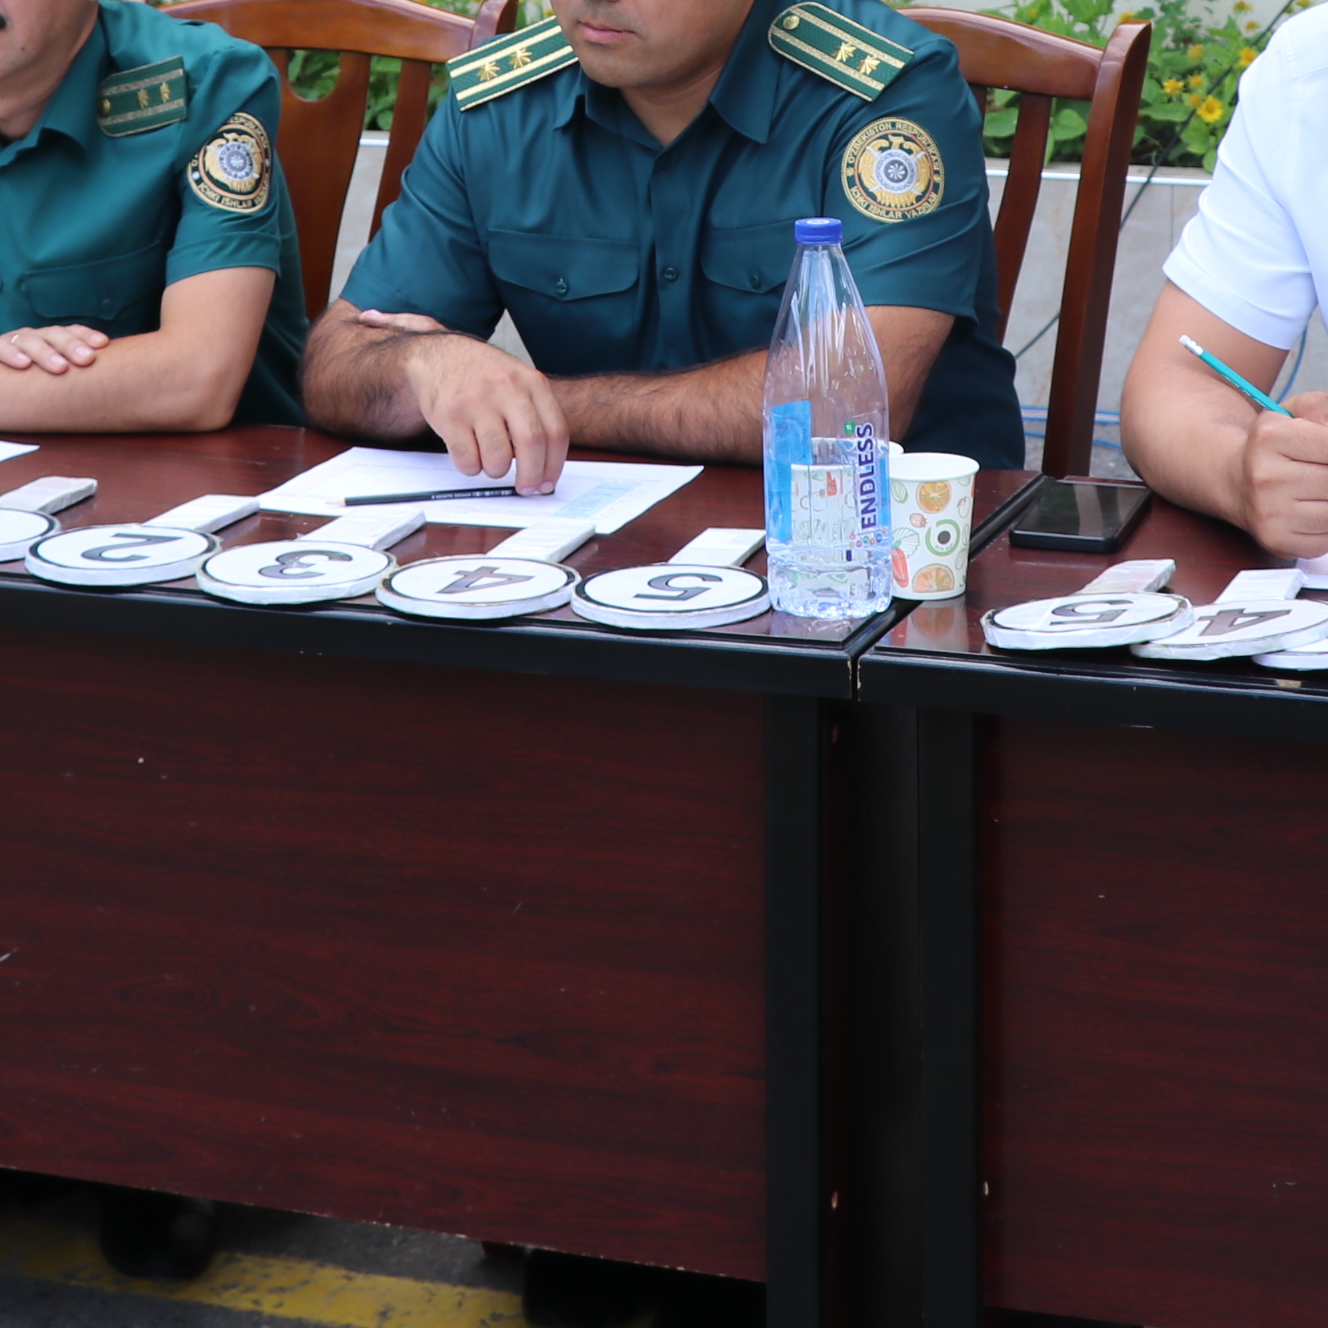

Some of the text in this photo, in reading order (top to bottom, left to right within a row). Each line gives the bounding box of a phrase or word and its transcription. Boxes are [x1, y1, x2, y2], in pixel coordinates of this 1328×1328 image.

[868, 205, 903, 219] ISHLAR
[856, 423, 877, 530] ENDLESS
[80, 532, 184, 562] 2
[258, 549, 353, 579] 3
[436, 566, 535, 595] 4
[633, 573, 723, 602] 5
[1050, 599, 1133, 626] 5
[1197, 608, 1292, 637] 4
